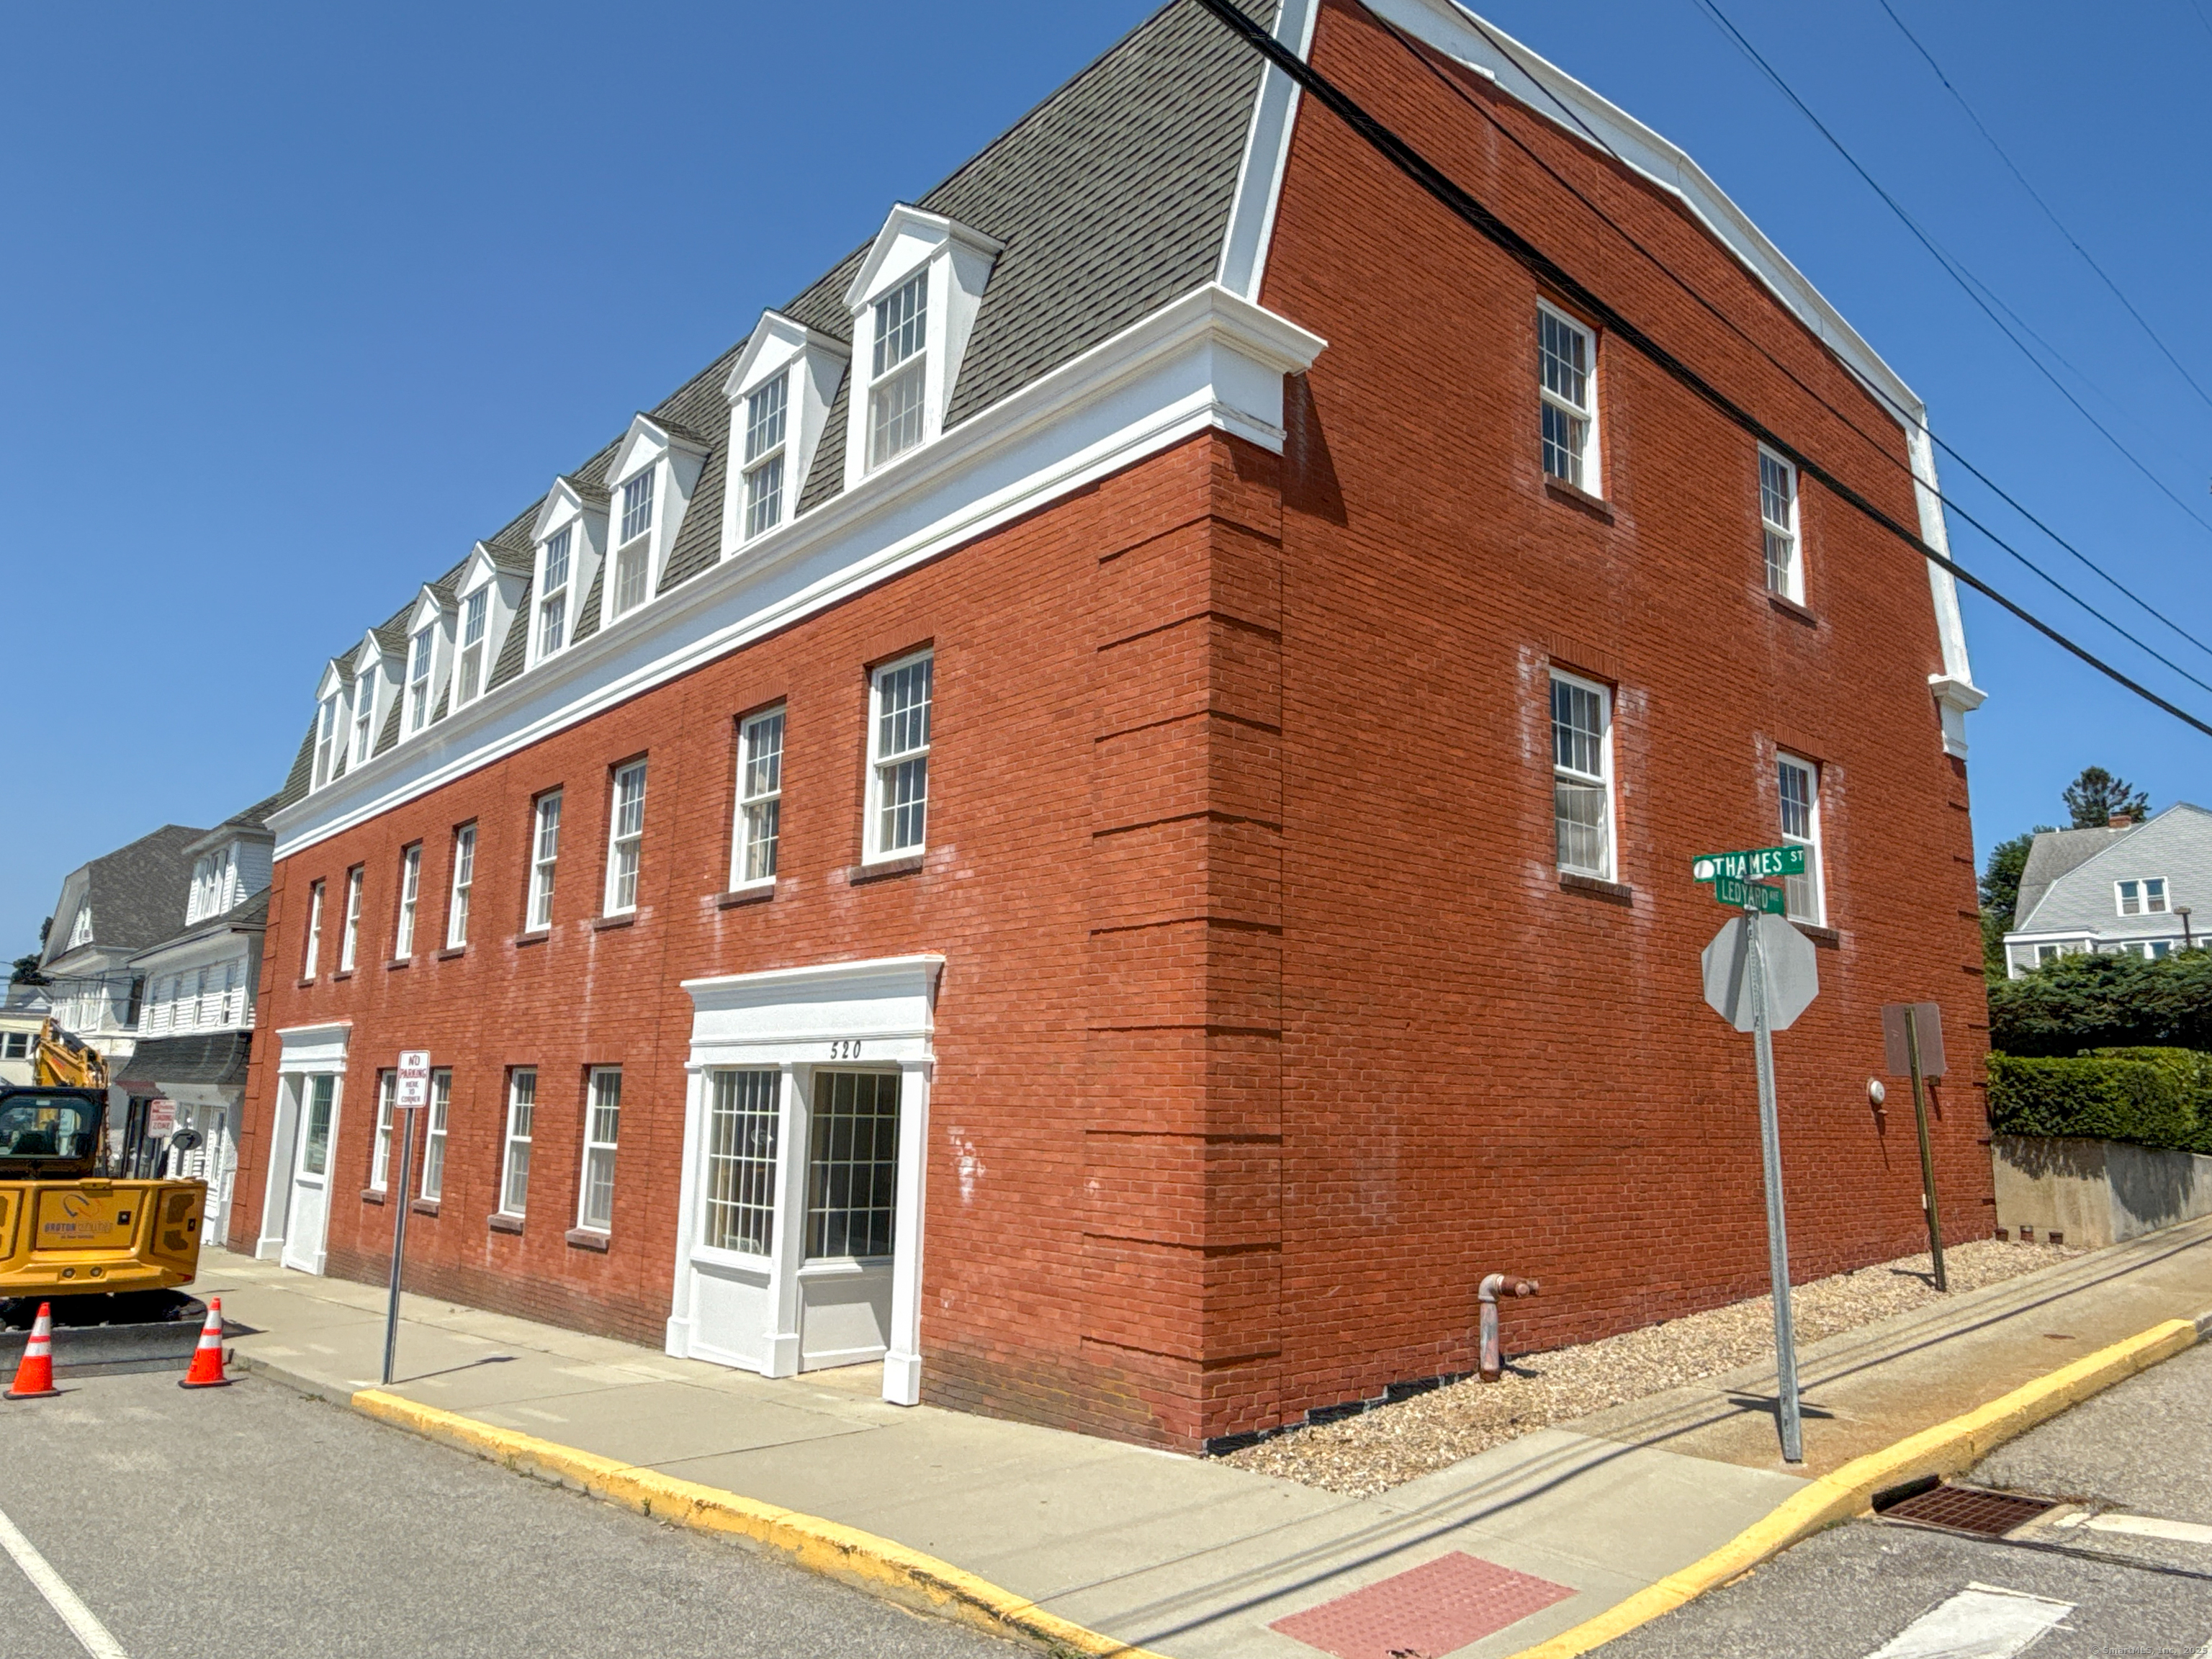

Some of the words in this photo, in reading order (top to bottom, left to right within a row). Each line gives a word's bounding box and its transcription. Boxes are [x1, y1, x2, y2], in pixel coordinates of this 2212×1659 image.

[1712, 851, 1782, 876] THAMES
[1791, 850, 1804, 862] ST
[1722, 879, 1768, 909] LEDYARD
[830, 1040, 861, 1060] 520
[408, 1055, 421, 1066] NO
[399, 1069, 426, 1079] PARKING
